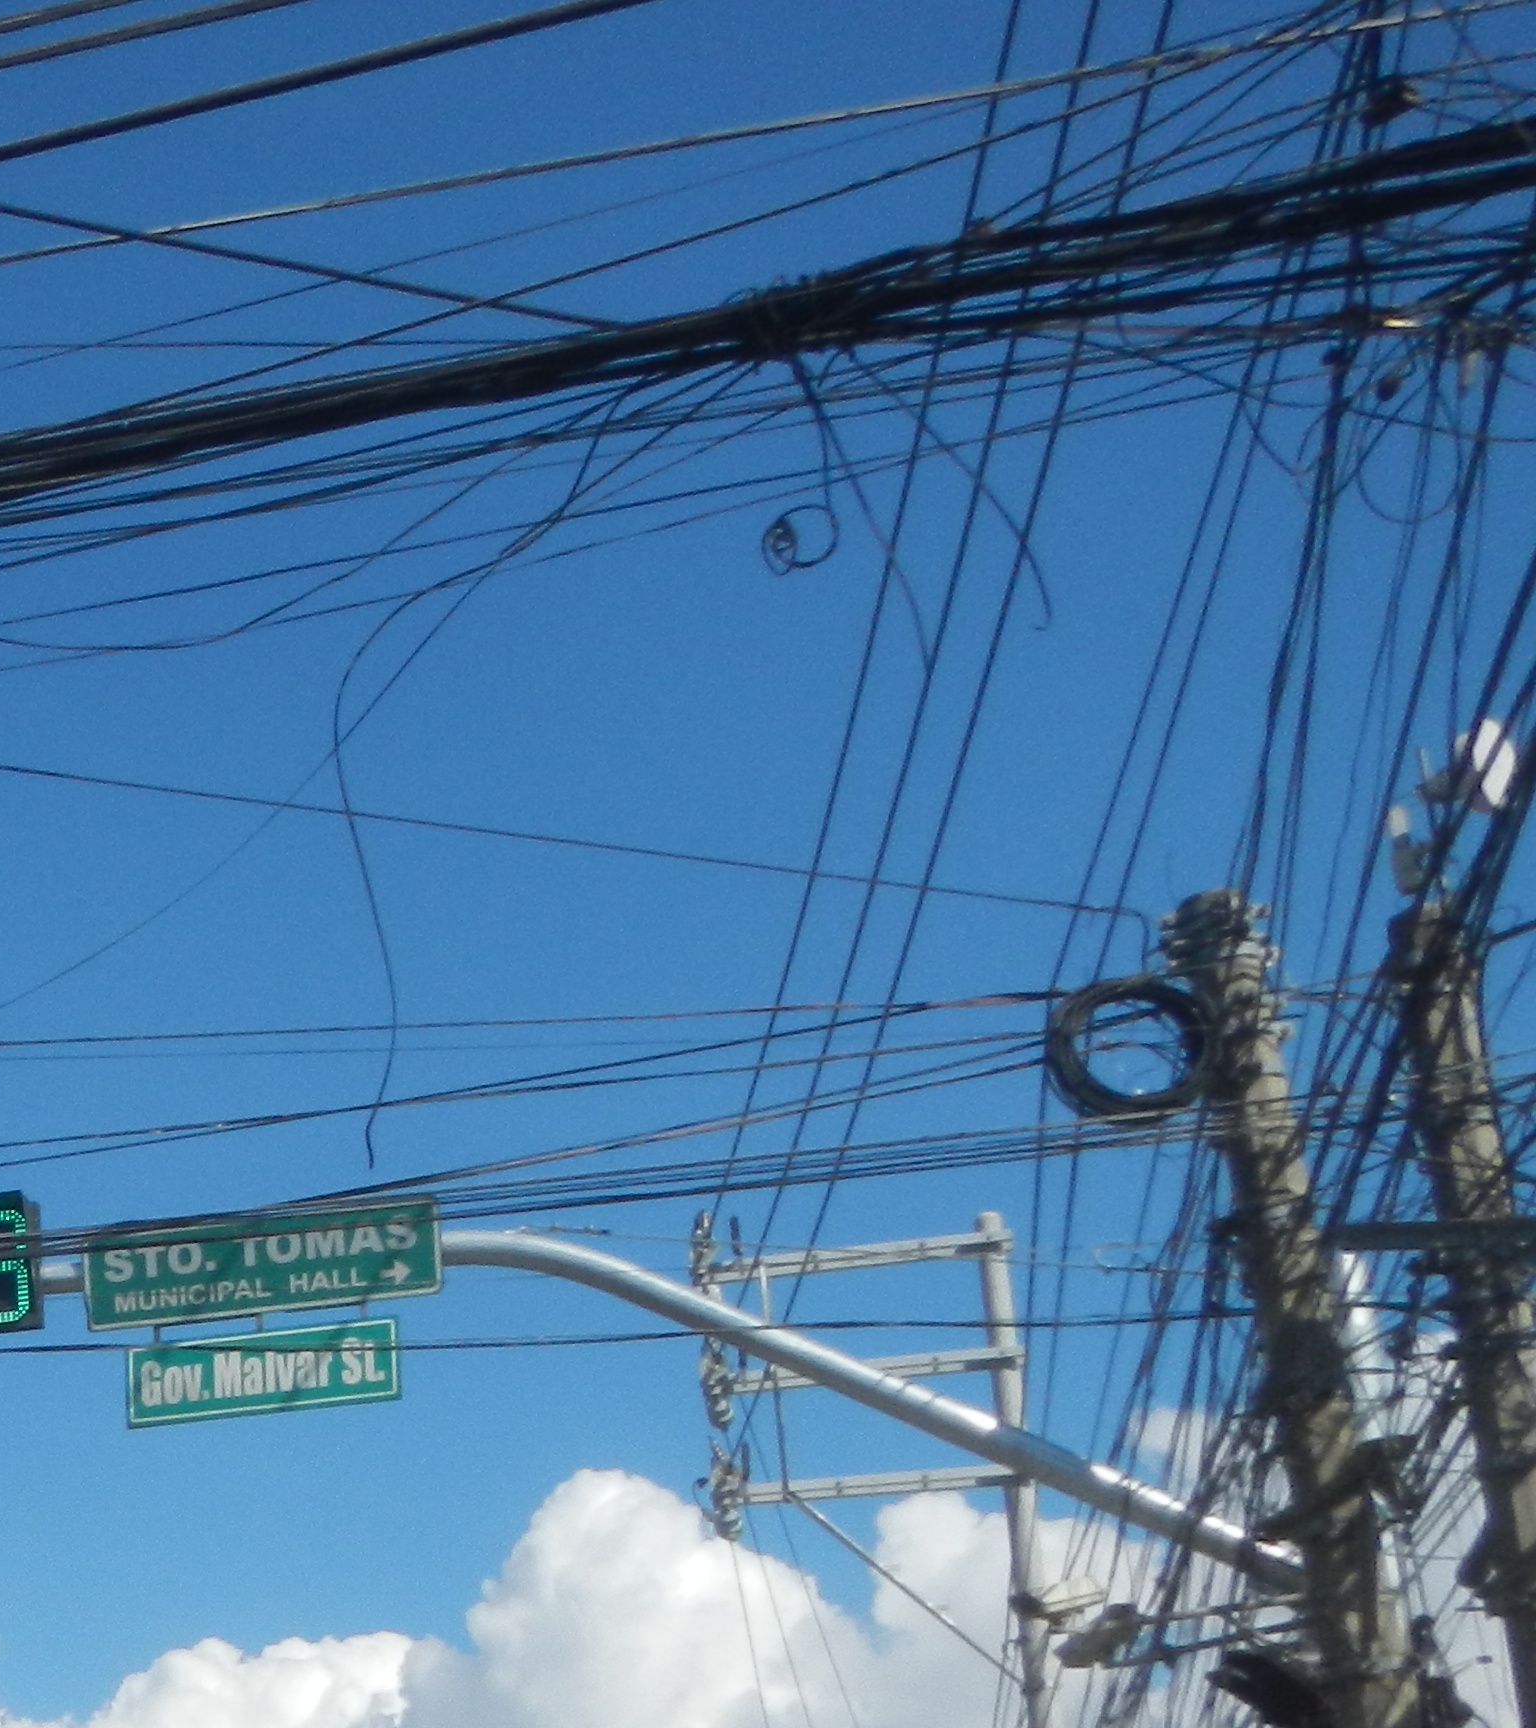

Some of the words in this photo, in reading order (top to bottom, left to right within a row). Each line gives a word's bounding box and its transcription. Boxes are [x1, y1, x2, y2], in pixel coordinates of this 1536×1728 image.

[103, 1243, 217, 1283] STO.
[241, 1214, 417, 1268] TOMAS
[114, 1277, 272, 1314] MUNICIPAL
[289, 1267, 368, 1294] HALL
[141, 1360, 210, 1407] Gov.
[214, 1349, 333, 1399] Malvar
[340, 1337, 386, 1386] St.
